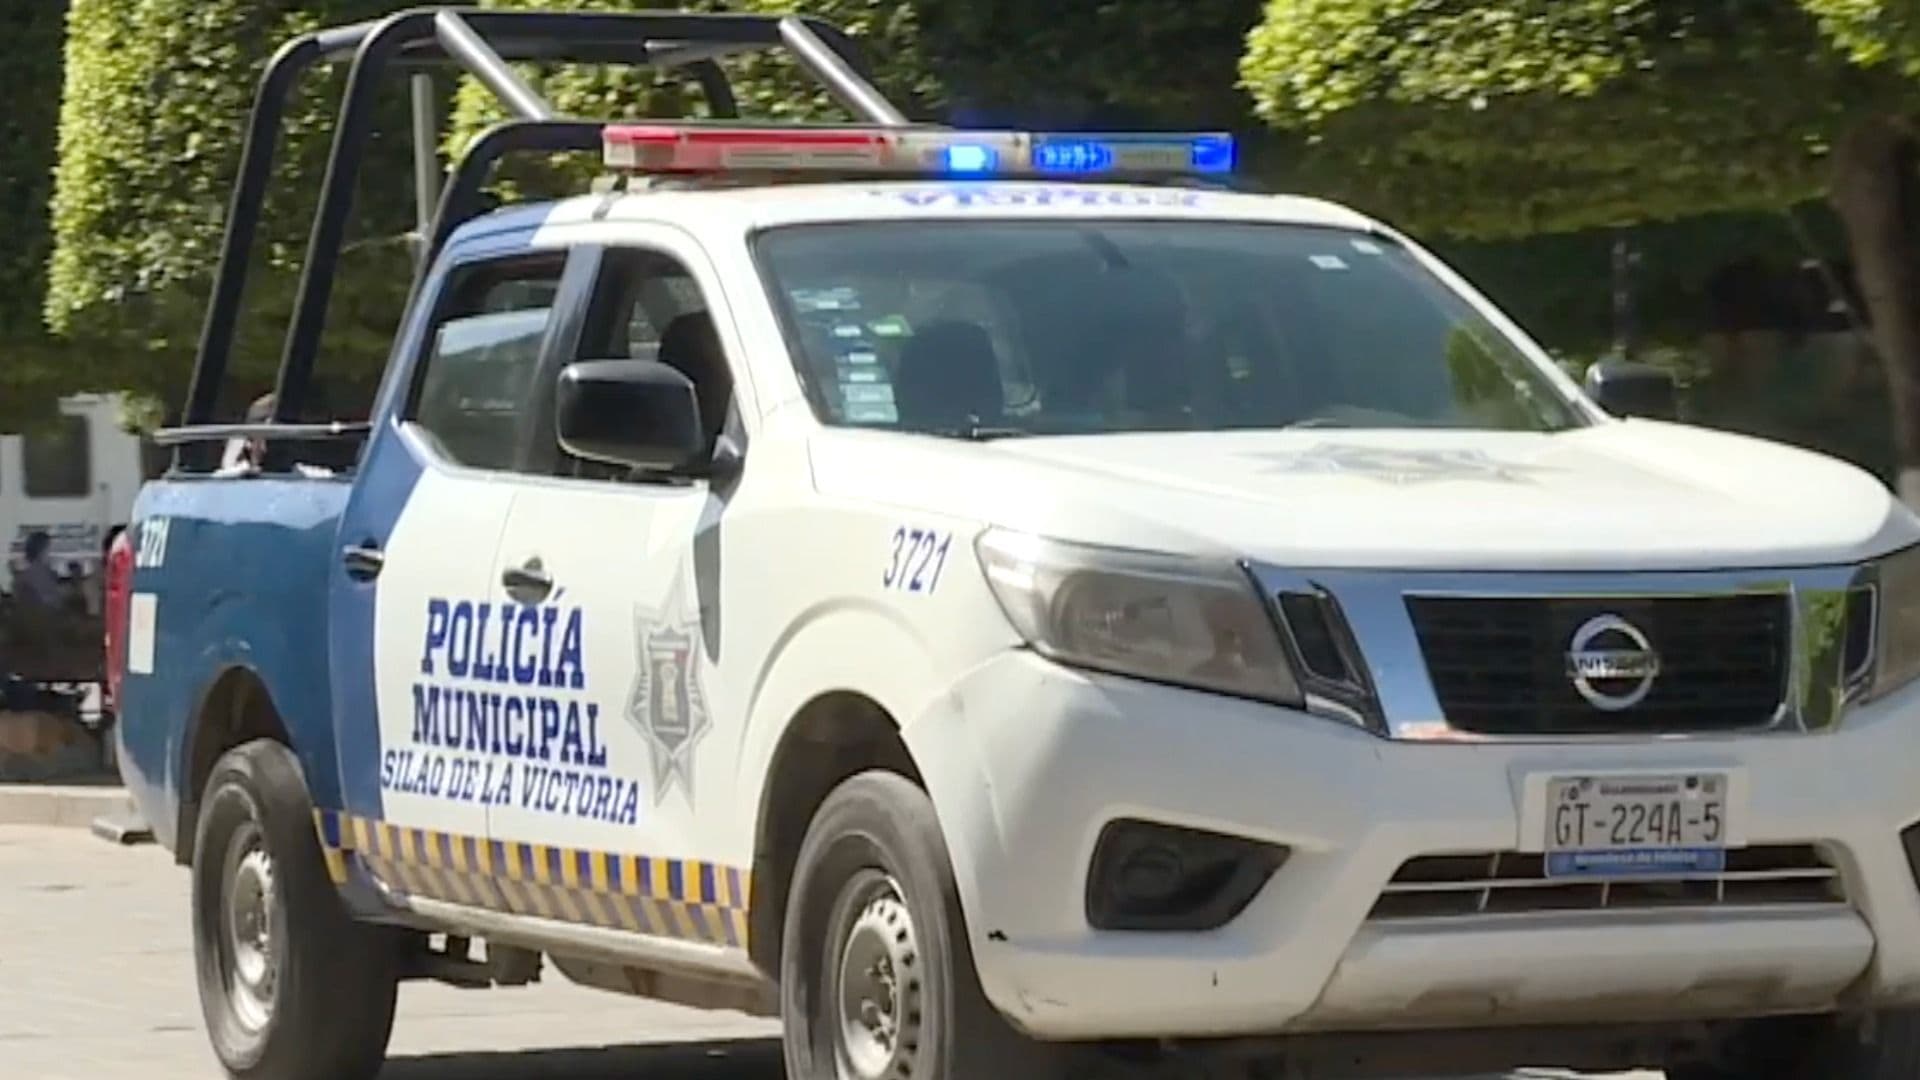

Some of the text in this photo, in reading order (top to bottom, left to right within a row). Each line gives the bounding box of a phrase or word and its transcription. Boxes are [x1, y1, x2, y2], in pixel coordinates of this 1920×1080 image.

[883, 525, 952, 595] 3721
[421, 587, 585, 689] POLICÍA
[412, 683, 607, 767] MUNICIPAL
[381, 750, 640, 824] SILAO DE LA VICTORIA
[1555, 801, 1721, 846] GT-224A-5
